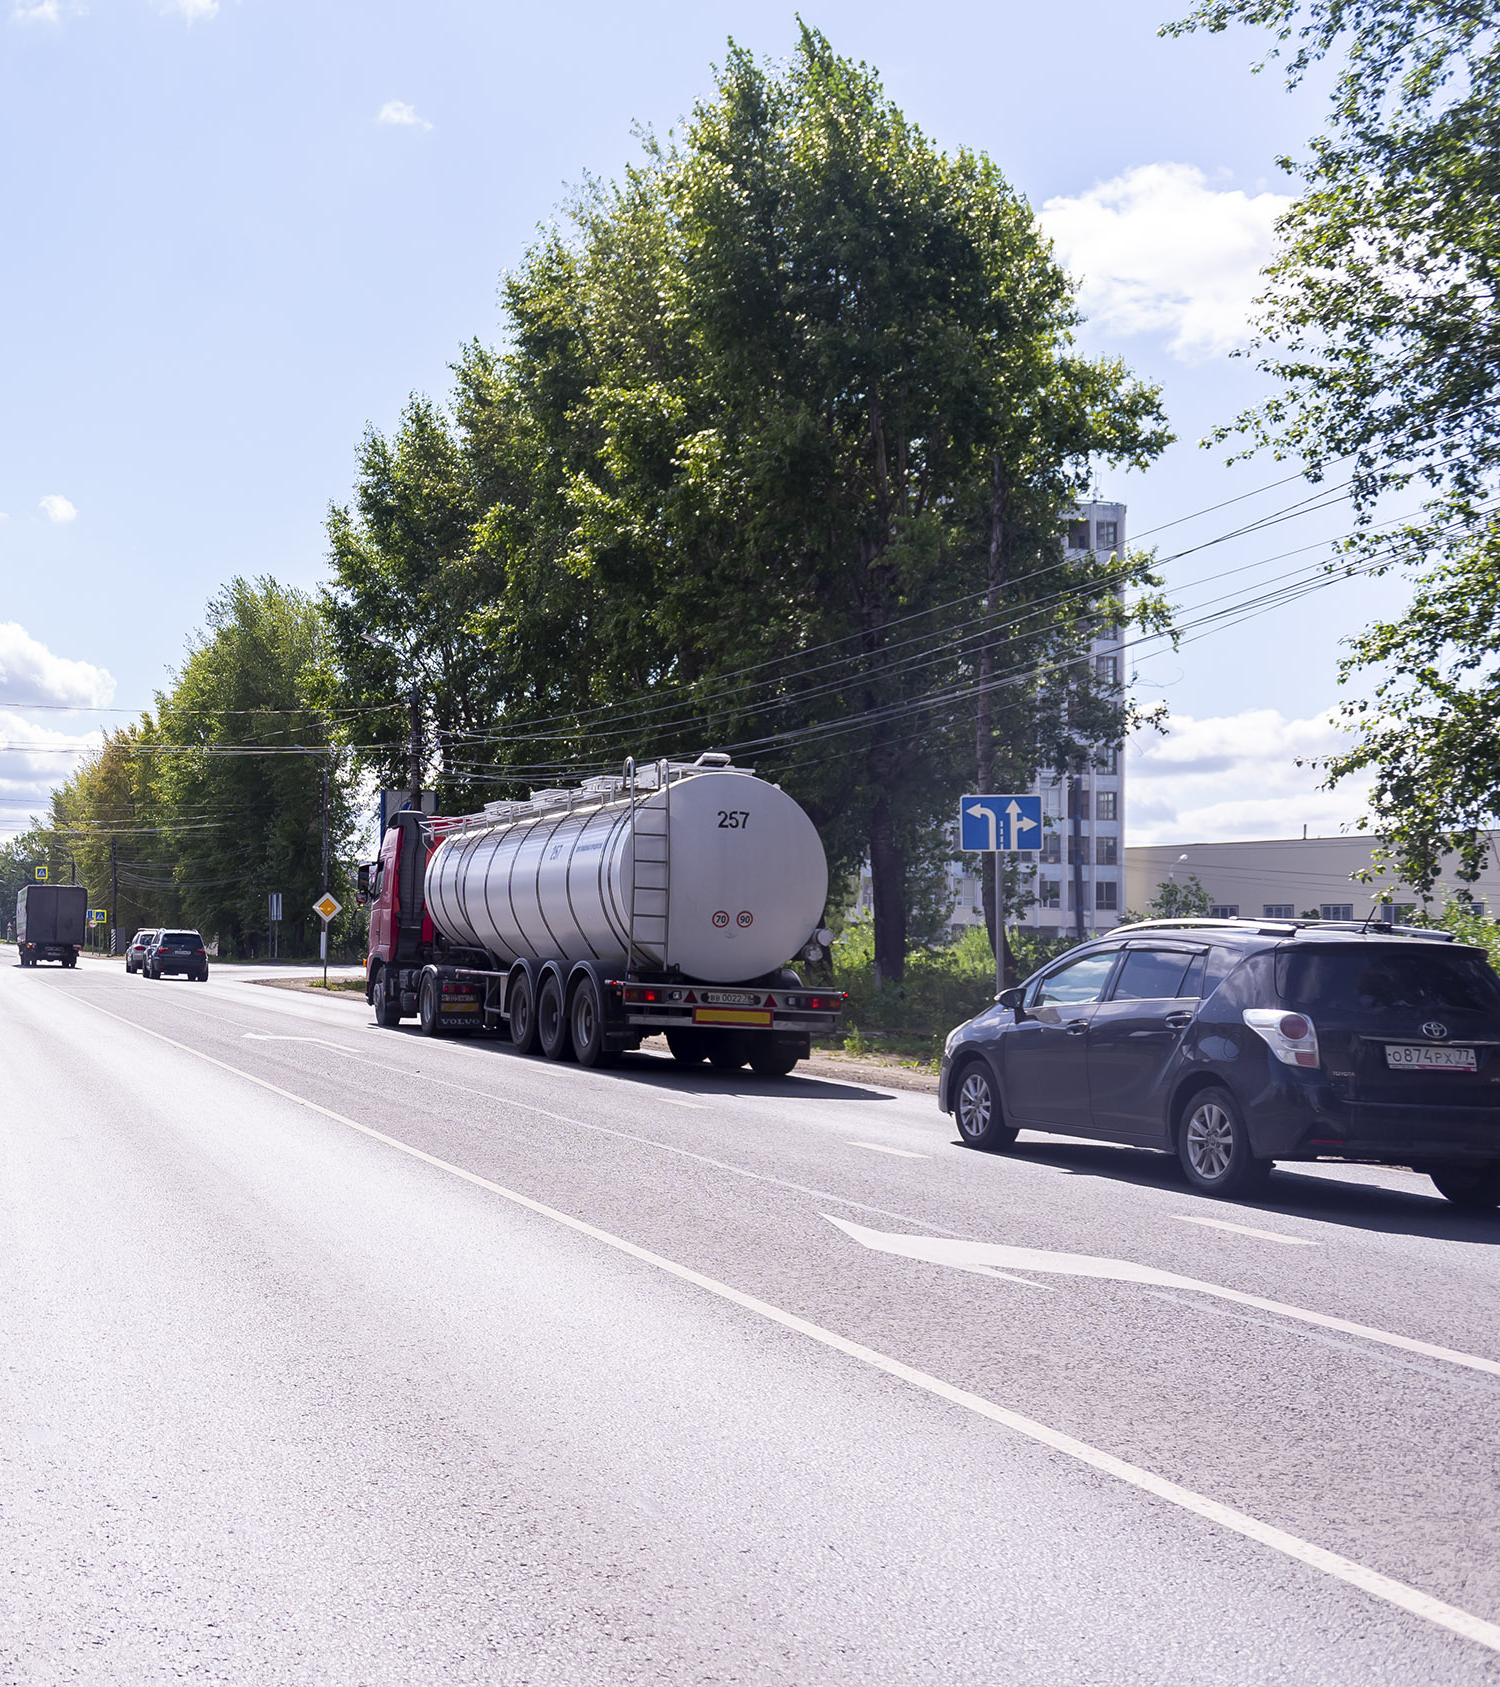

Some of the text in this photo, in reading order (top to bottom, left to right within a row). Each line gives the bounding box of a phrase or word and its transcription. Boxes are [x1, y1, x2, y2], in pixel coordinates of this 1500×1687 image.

[717, 810, 750, 829] 257
[716, 915, 727, 923] 70
[740, 915, 750, 923] 90
[1456, 1049, 1470, 1061] 77
